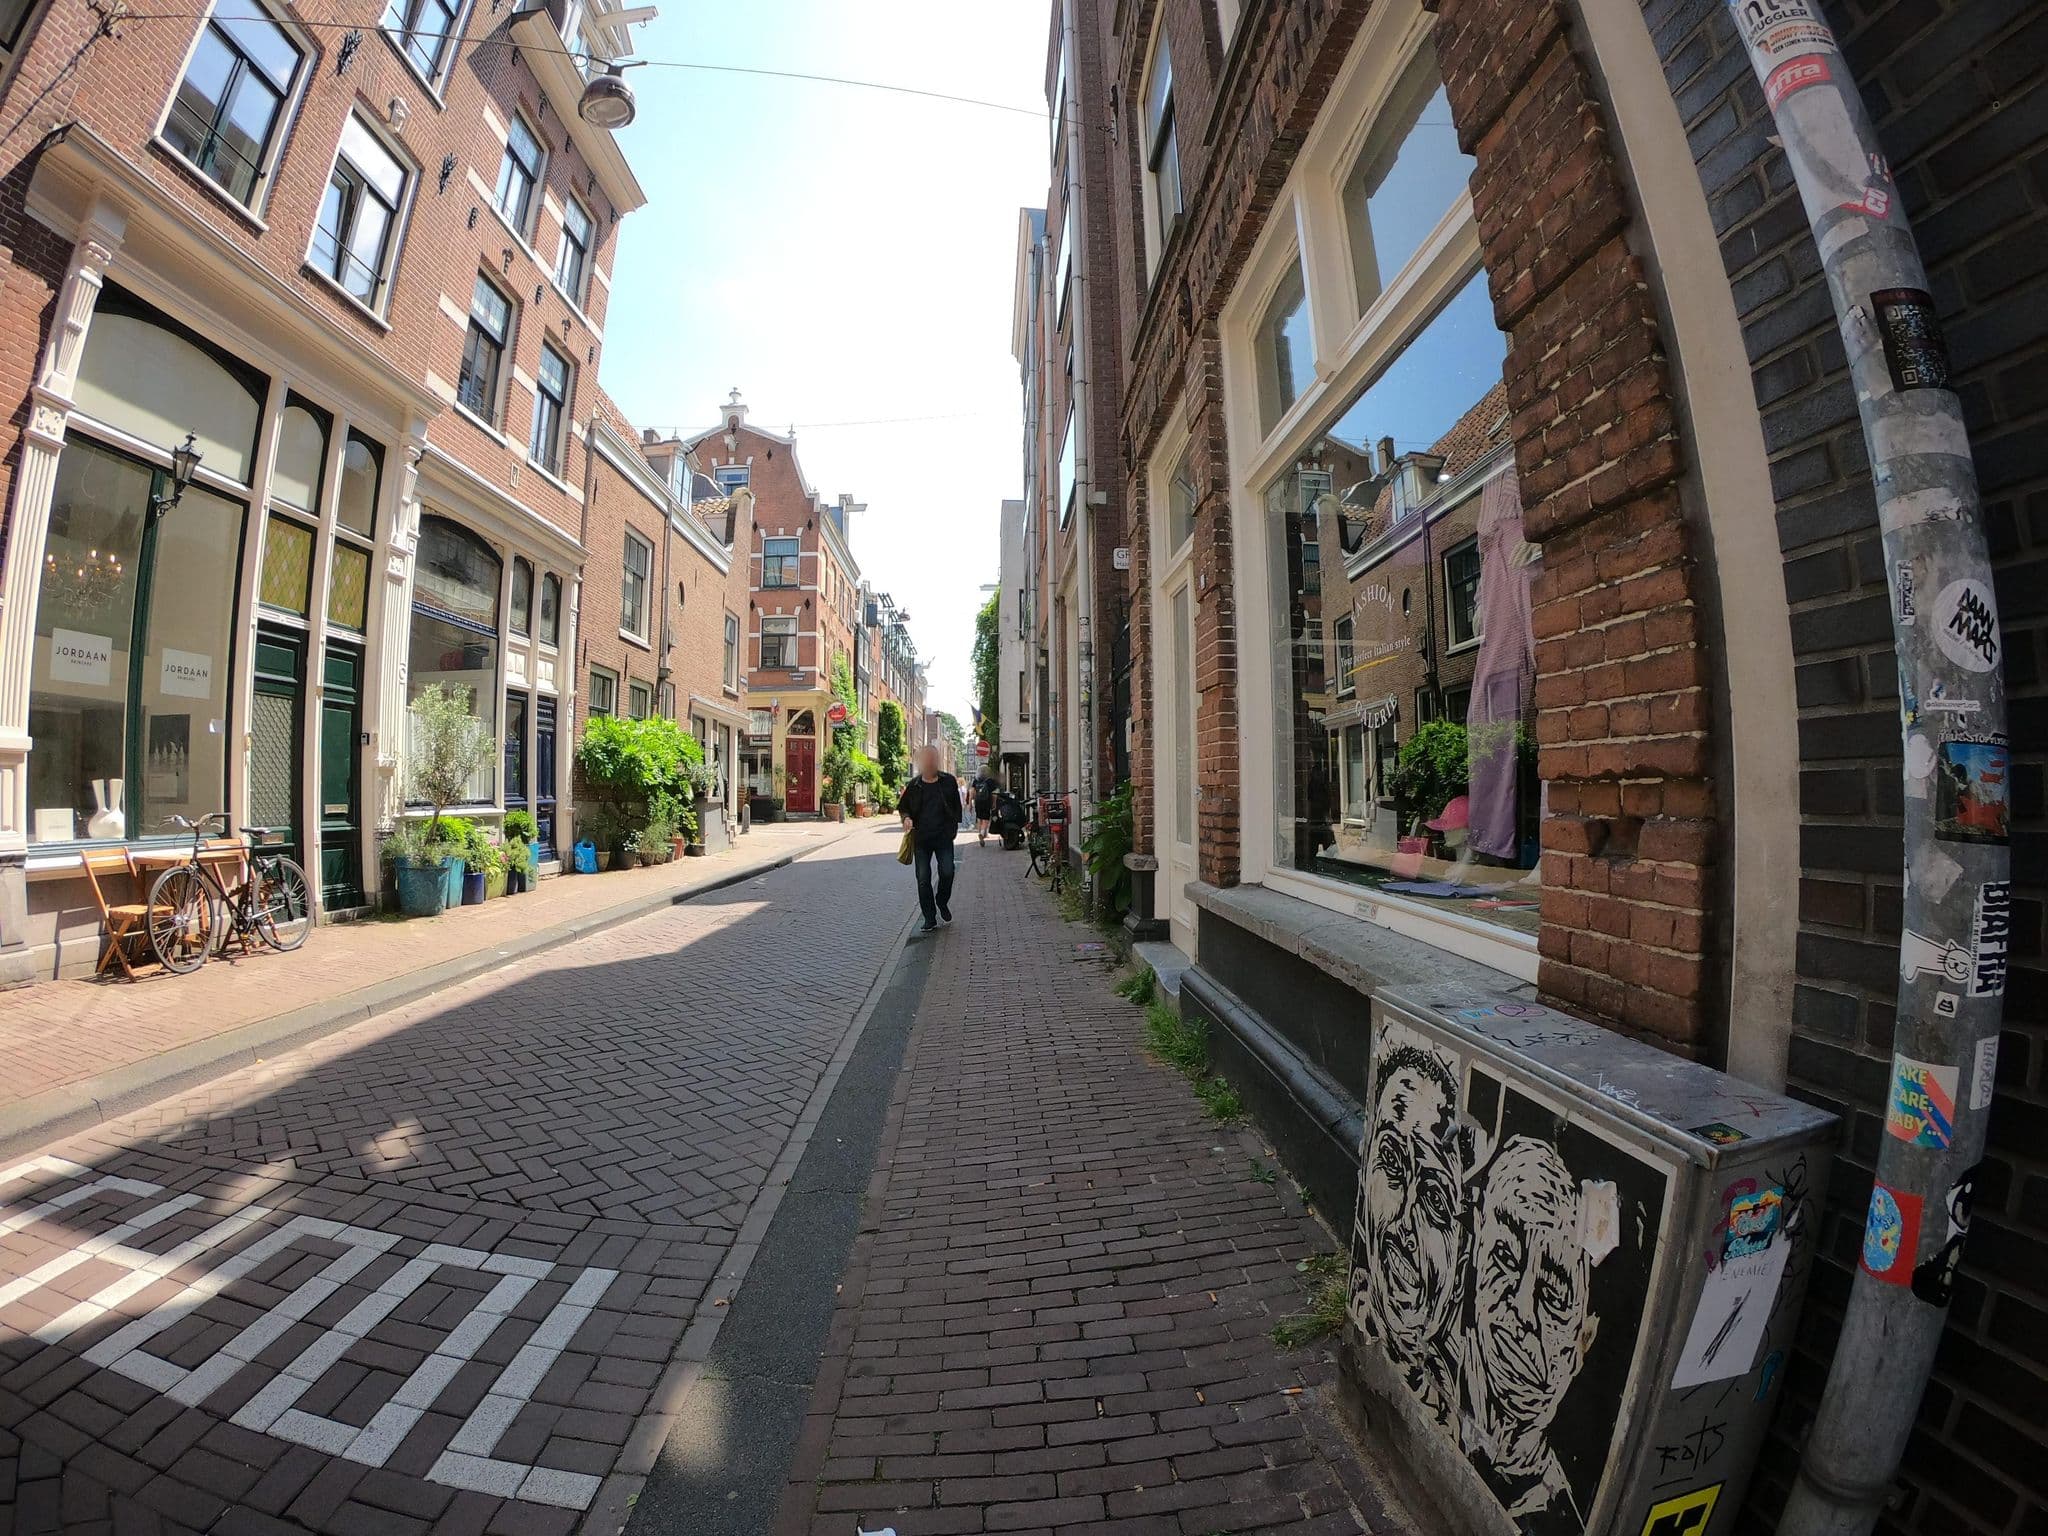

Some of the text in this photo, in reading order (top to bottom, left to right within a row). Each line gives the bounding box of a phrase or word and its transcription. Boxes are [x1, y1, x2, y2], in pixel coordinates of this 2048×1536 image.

[1350, 583, 1396, 627] FASHION
[55, 646, 107, 662] JORDAAN
[1353, 649, 1373, 667] perfect
[164, 663, 208, 678] JORDAAN
